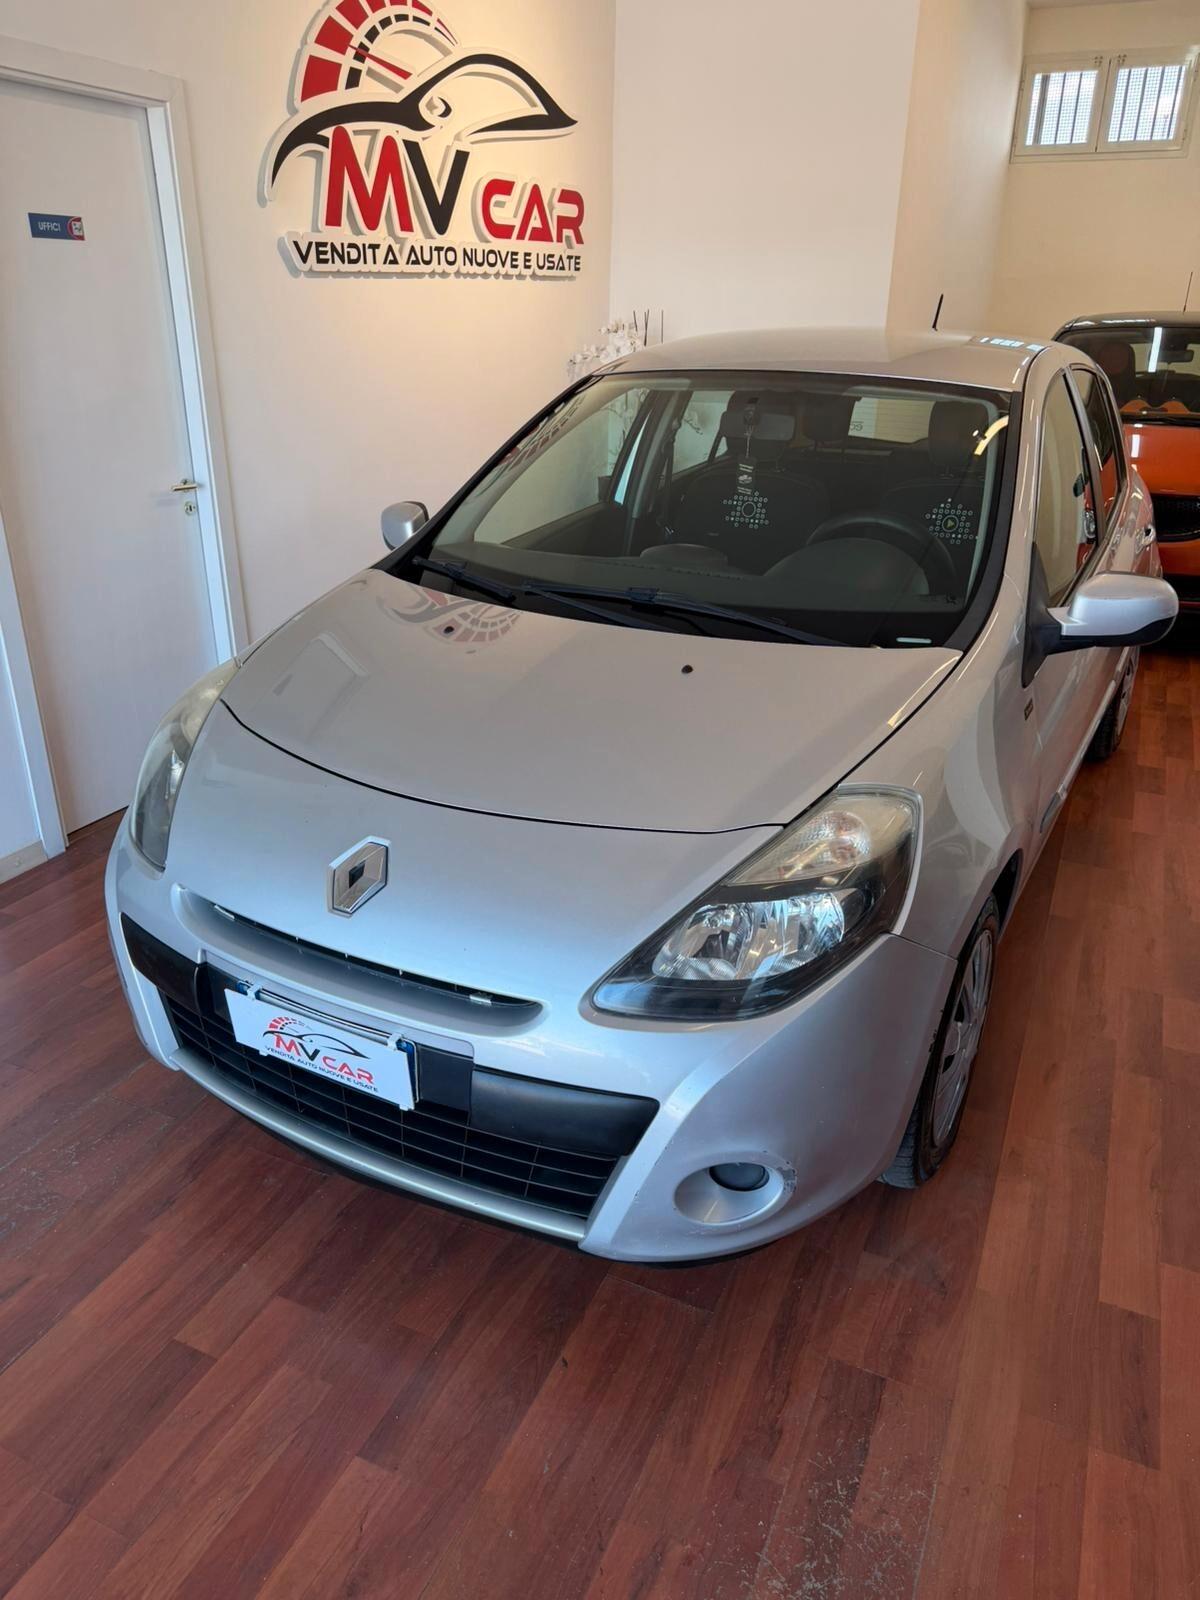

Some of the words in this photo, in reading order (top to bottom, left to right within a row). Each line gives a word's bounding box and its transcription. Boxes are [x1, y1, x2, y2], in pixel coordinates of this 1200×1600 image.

[325, 126, 470, 235] MV
[482, 179, 585, 244] CAR
[38, 221, 61, 232] UFFICI
[293, 240, 399, 265] VENDITA
[405, 246, 457, 266] AUTO
[463, 248, 519, 269] NUOVE
[523, 253, 531, 269] E
[536, 252, 581, 271] USATE
[273, 1033, 320, 1061] MV
[322, 1055, 374, 1084] CAR
